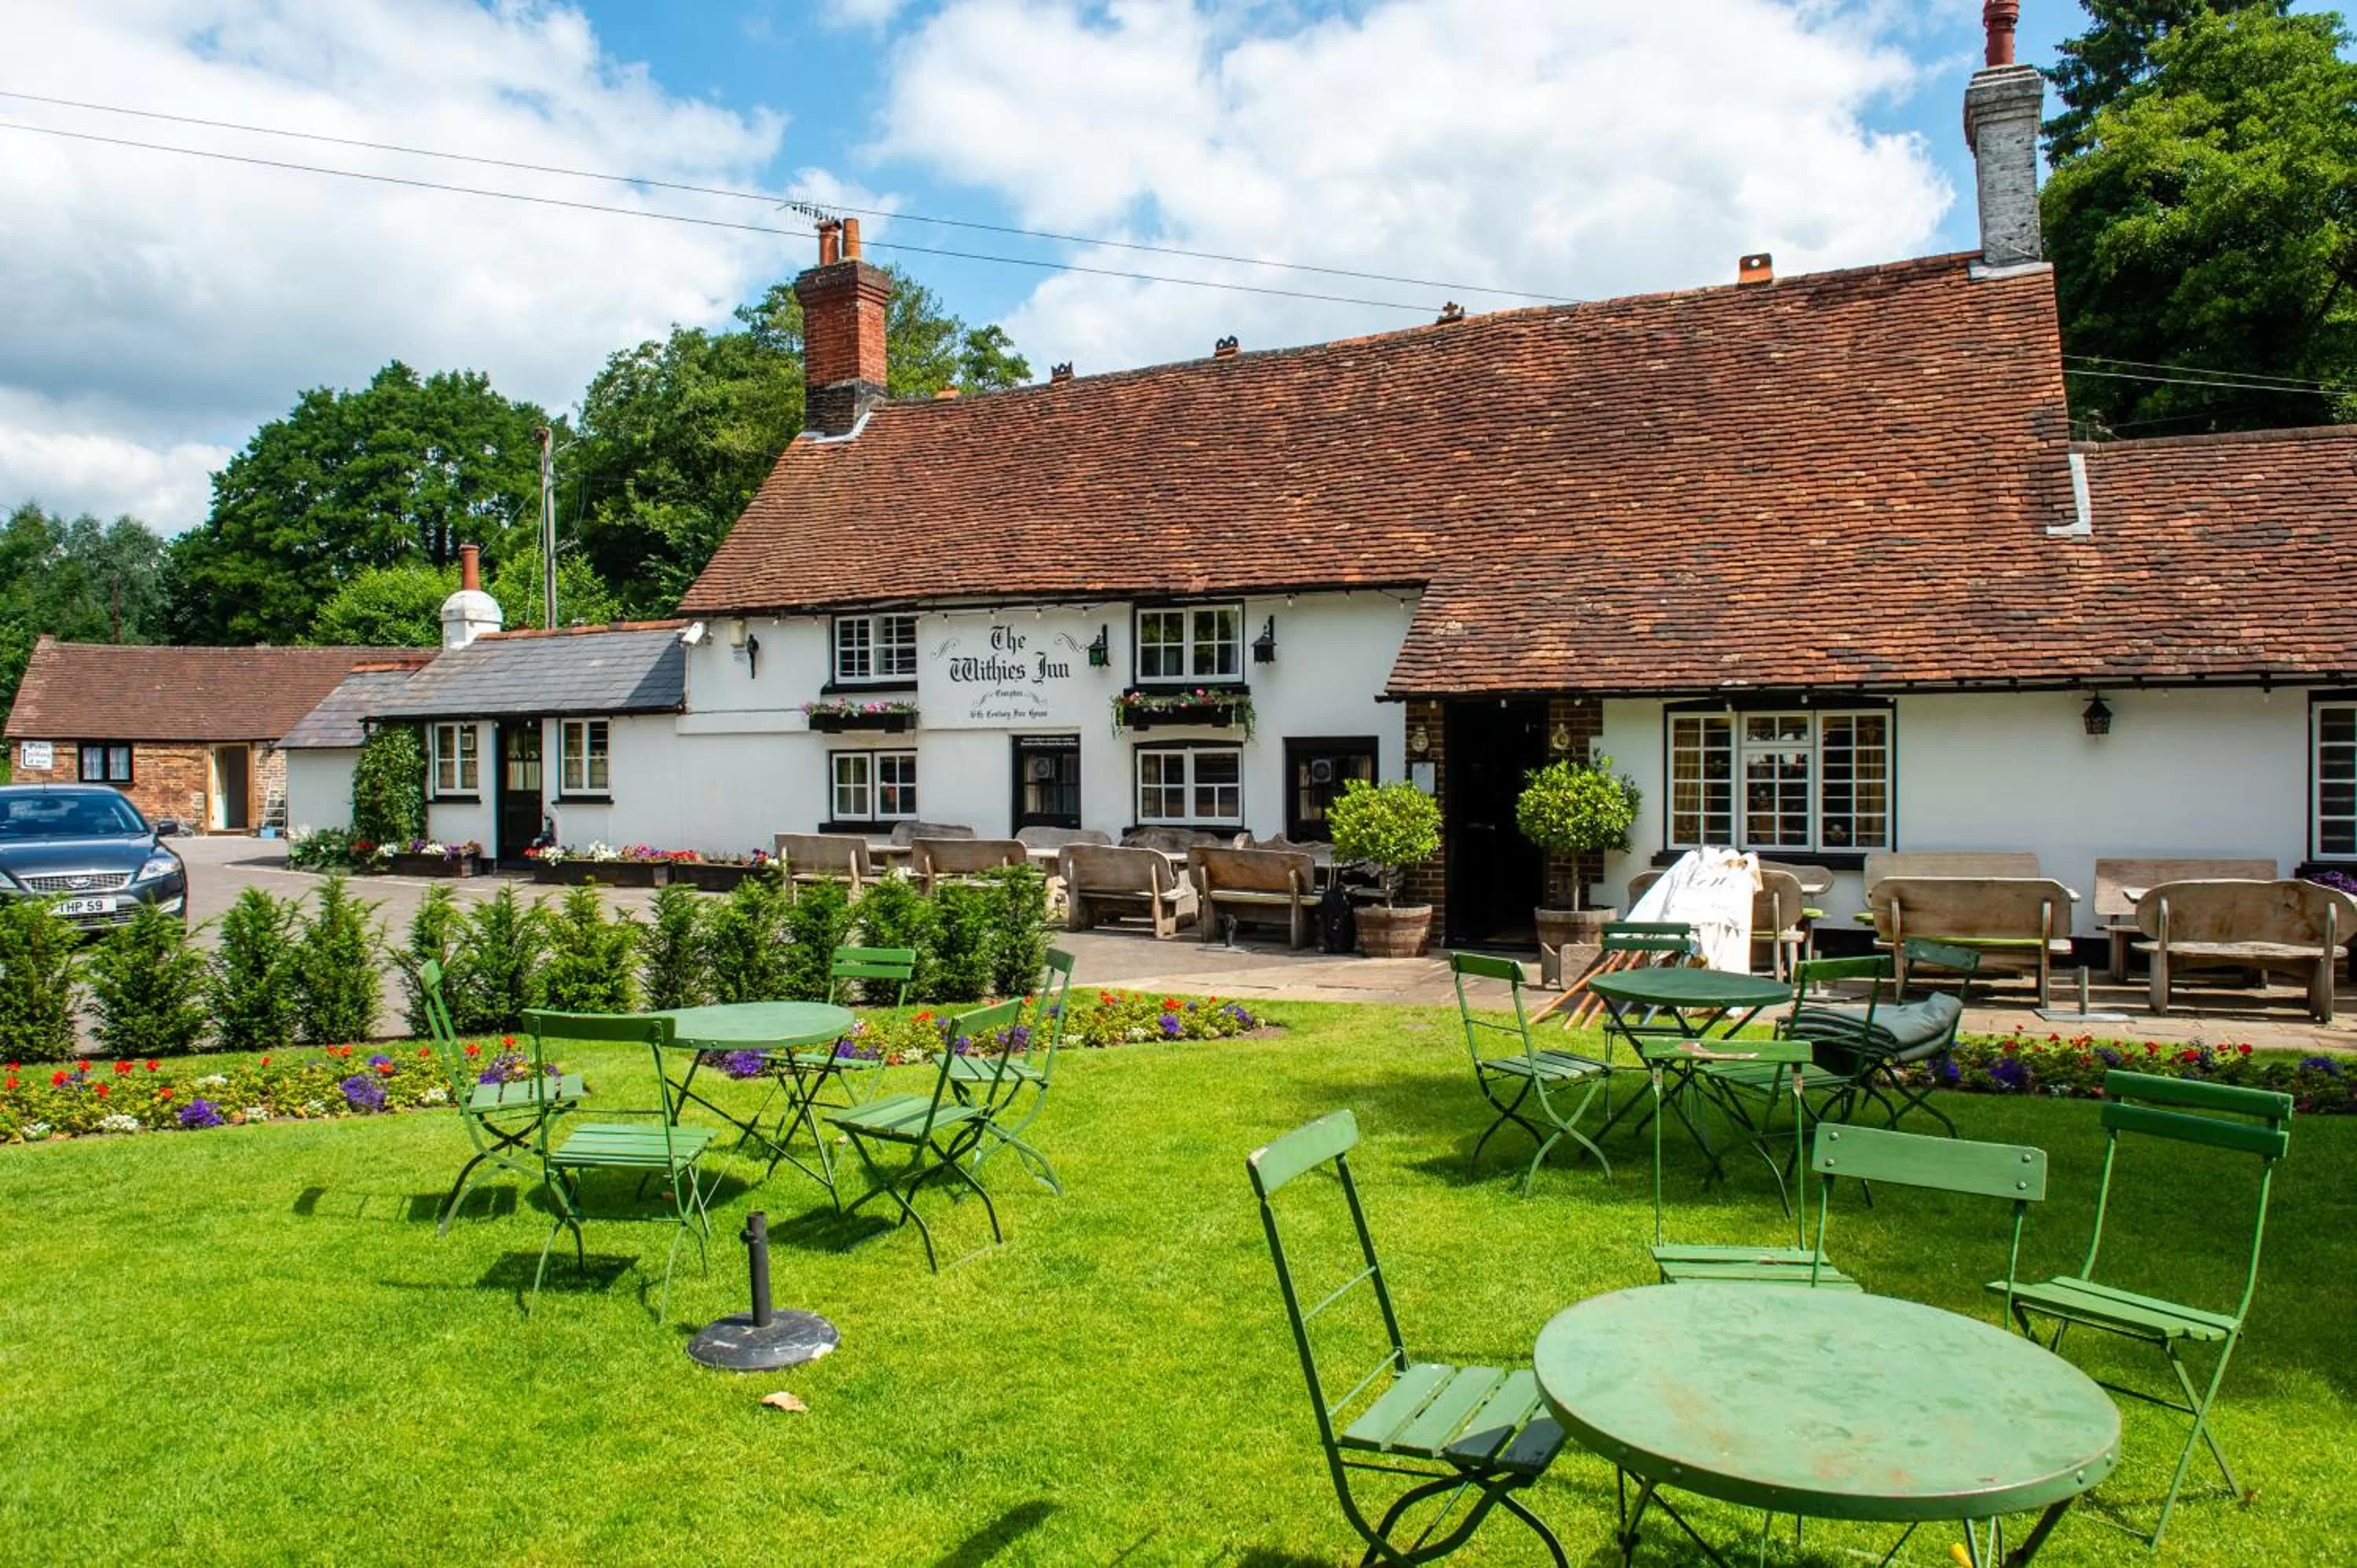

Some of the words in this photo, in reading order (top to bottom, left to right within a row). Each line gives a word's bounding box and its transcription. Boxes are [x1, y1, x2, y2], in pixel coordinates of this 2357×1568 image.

[990, 625, 1026, 654] The
[949, 654, 1026, 685] Withies
[1032, 651, 1070, 685] Inn
[87, 899, 103, 911] 59
